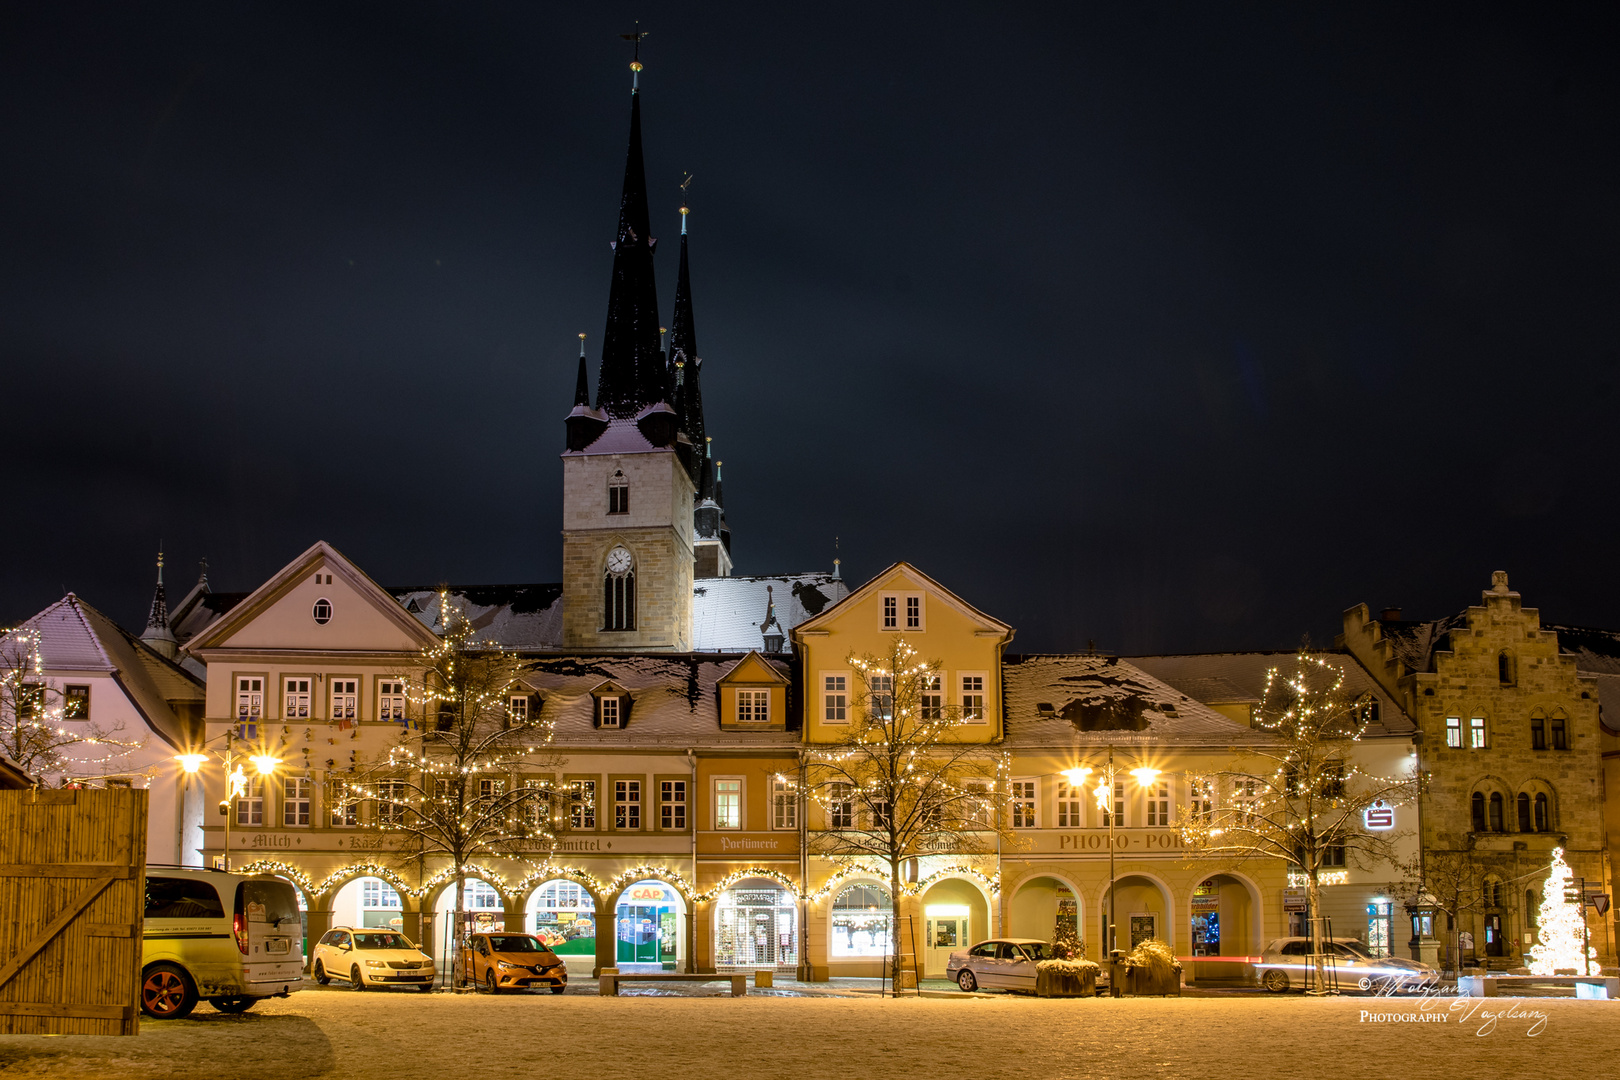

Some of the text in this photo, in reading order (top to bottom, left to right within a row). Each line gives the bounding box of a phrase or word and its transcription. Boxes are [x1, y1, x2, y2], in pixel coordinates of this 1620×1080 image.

[251, 834, 291, 848] Milch
[720, 836, 779, 851] Parfümerie
[1059, 833, 1129, 850] PHOTO
[633, 888, 661, 899] CAP
